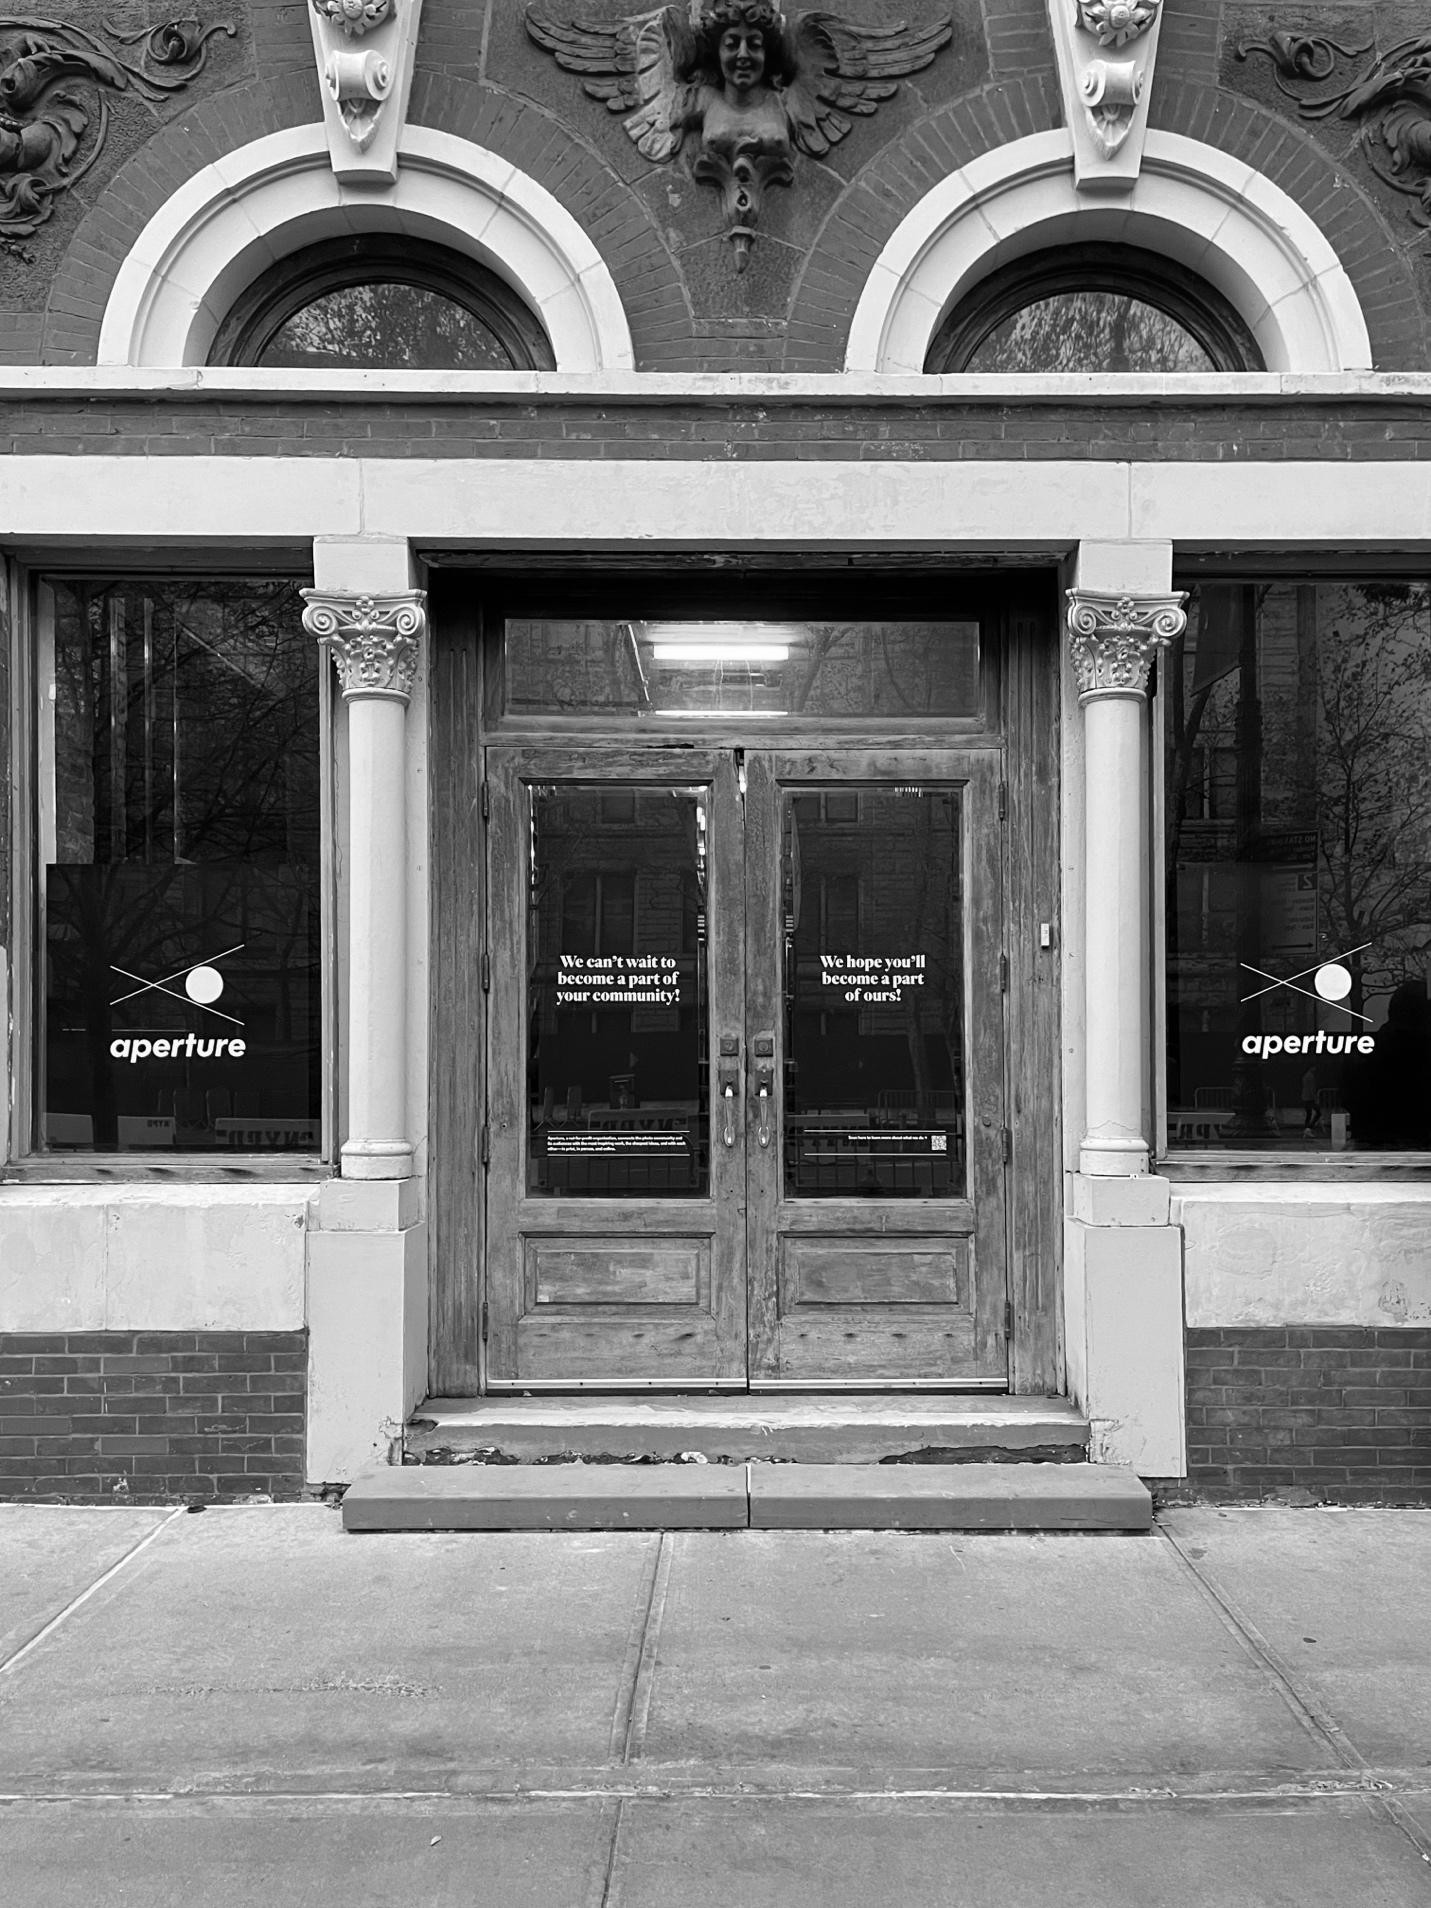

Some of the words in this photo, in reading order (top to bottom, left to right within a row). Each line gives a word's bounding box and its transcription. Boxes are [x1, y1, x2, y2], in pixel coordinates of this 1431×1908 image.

[560, 955, 584, 968] We
[586, 955, 624, 968] can't
[626, 955, 658, 968] wait
[660, 956, 677, 968] to
[820, 955, 844, 968] We
[846, 955, 883, 971] hope
[885, 955, 926, 971] you'll
[557, 971, 615, 985] become
[617, 974, 626, 985] a
[628, 973, 660, 988] part
[662, 971, 680, 985] of
[822, 971, 879, 985] become
[881, 974, 890, 985] a
[893, 973, 925, 988] part
[556, 990, 591, 1005] your
[592, 988, 681, 1005] community!
[845, 988, 863, 1002] of
[864, 988, 902, 1002] ours!
[109, 1033, 246, 1063] aperture
[1242, 1030, 1375, 1059] aperture
